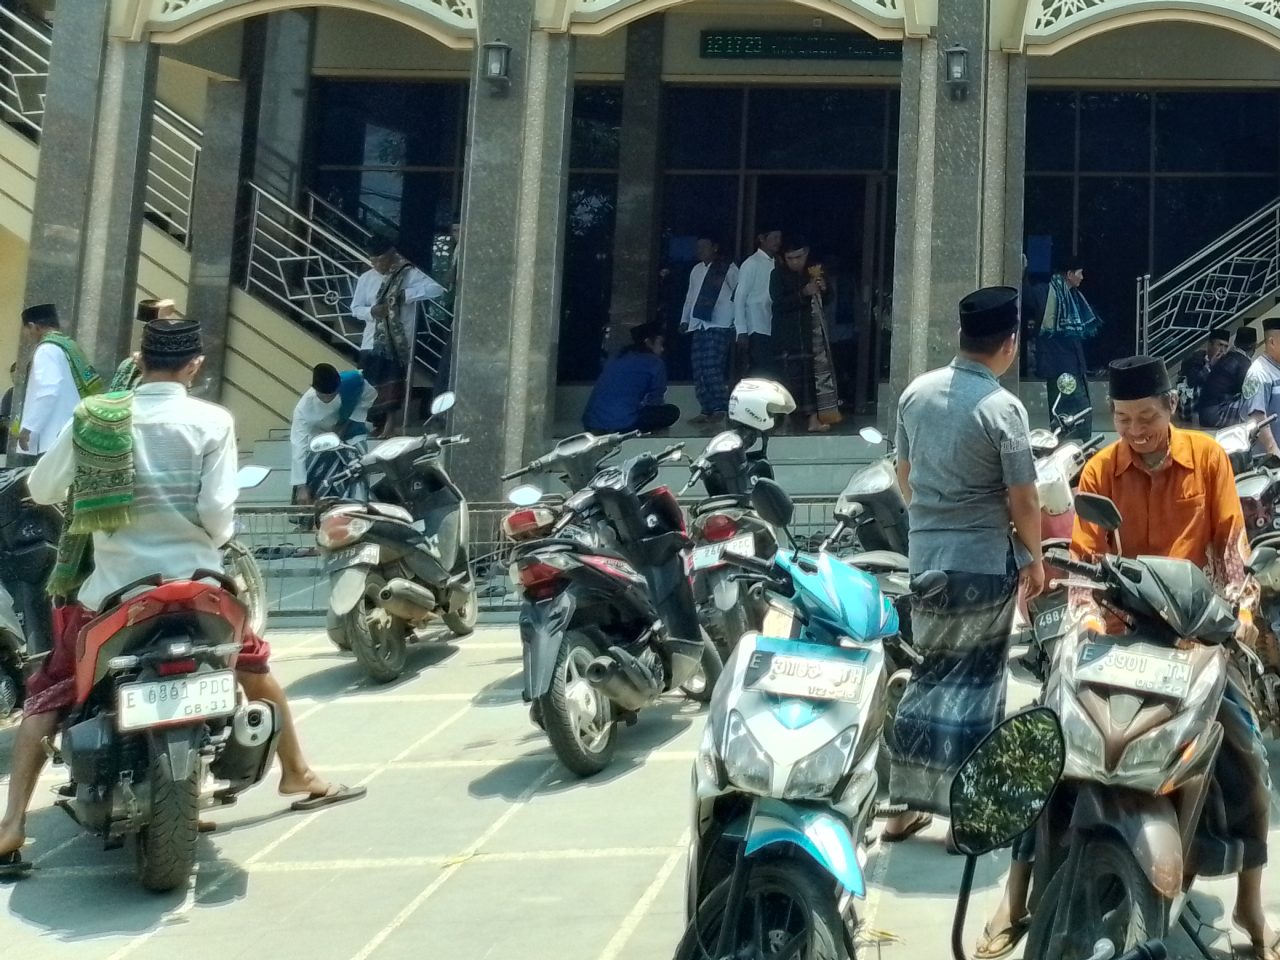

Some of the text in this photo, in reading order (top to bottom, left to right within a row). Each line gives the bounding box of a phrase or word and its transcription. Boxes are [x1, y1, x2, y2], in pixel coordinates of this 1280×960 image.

[749, 653, 763, 669] E
[1082, 646, 1095, 661] E
[126, 691, 137, 709] E
[199, 677, 231, 696] PDC
